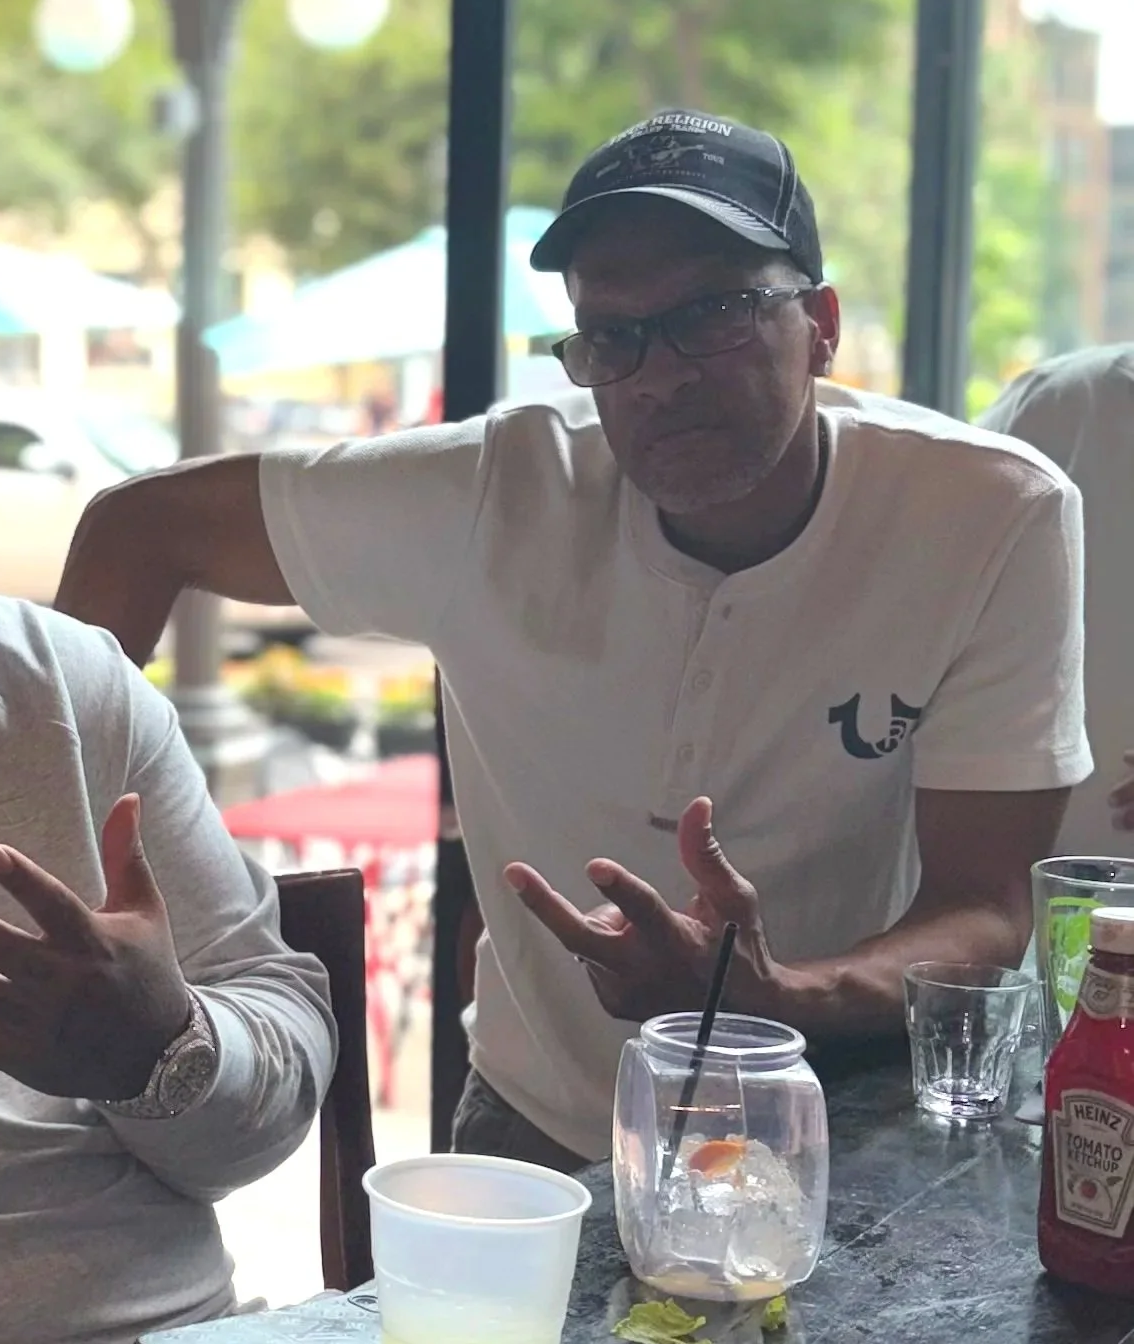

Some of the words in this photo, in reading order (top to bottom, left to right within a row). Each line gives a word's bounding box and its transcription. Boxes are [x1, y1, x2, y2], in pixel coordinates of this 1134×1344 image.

[651, 114, 733, 137] RELIGION
[1073, 1104, 1122, 1131] HEINZ
[1067, 1132, 1123, 1162] TOMATO
[1067, 1148, 1119, 1173] KETCHUP
